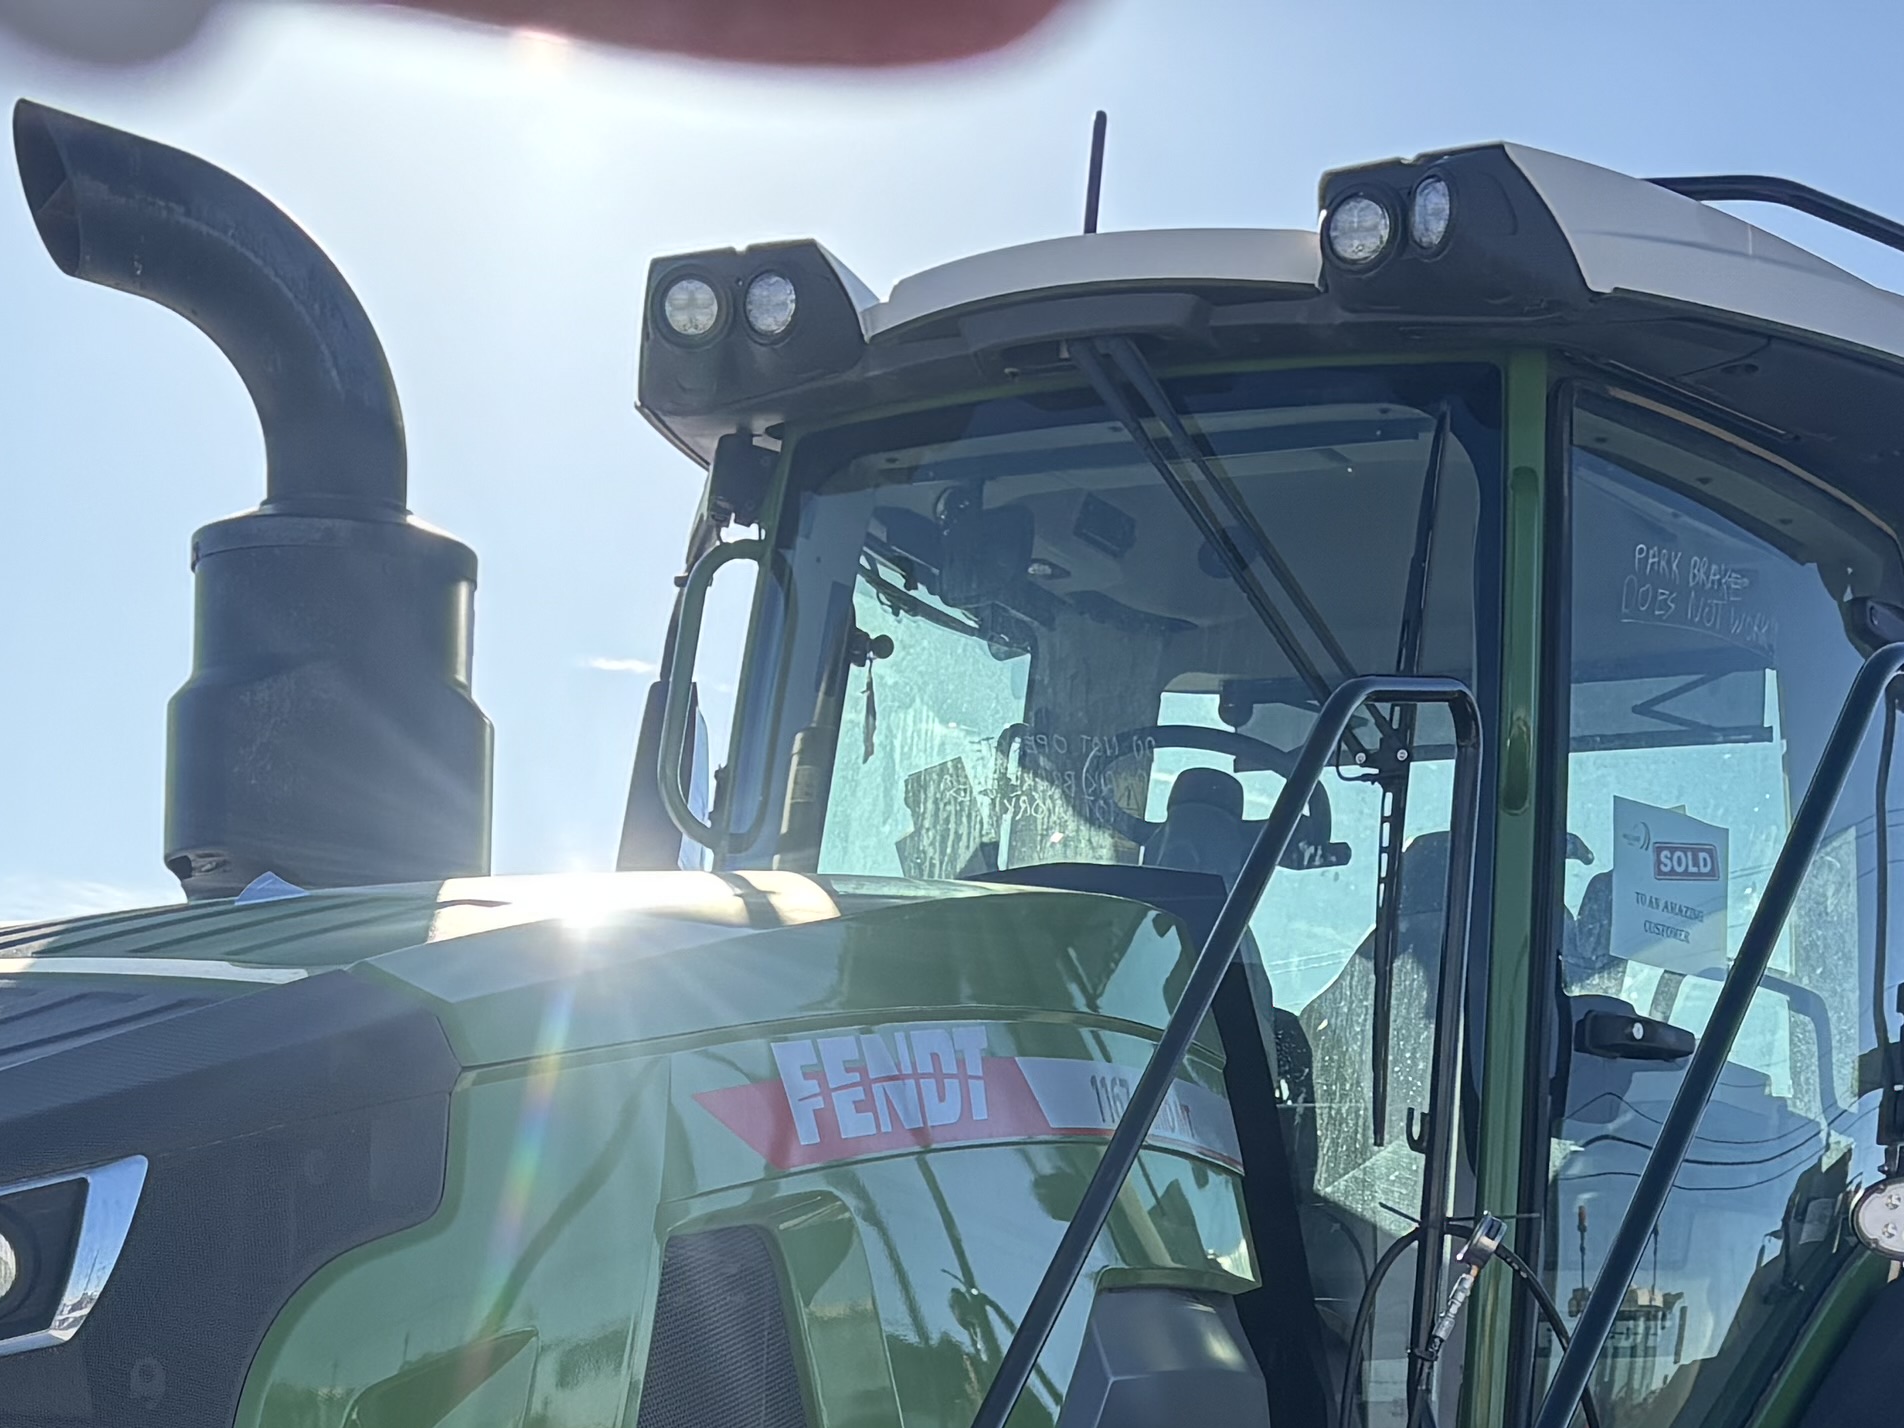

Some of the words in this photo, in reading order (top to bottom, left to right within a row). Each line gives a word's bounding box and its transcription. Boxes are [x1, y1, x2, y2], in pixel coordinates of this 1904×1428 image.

[1635, 544, 1682, 584] PARK
[1689, 556, 1749, 601] BRAKE
[1621, 574, 1677, 620] DOES
[1688, 590, 1728, 630] NOT
[1660, 851, 1712, 873] SOLD
[1662, 900, 1704, 923] AMAZING
[1644, 920, 1690, 944] CUSTOMER
[771, 1026, 989, 1145] FENDT
